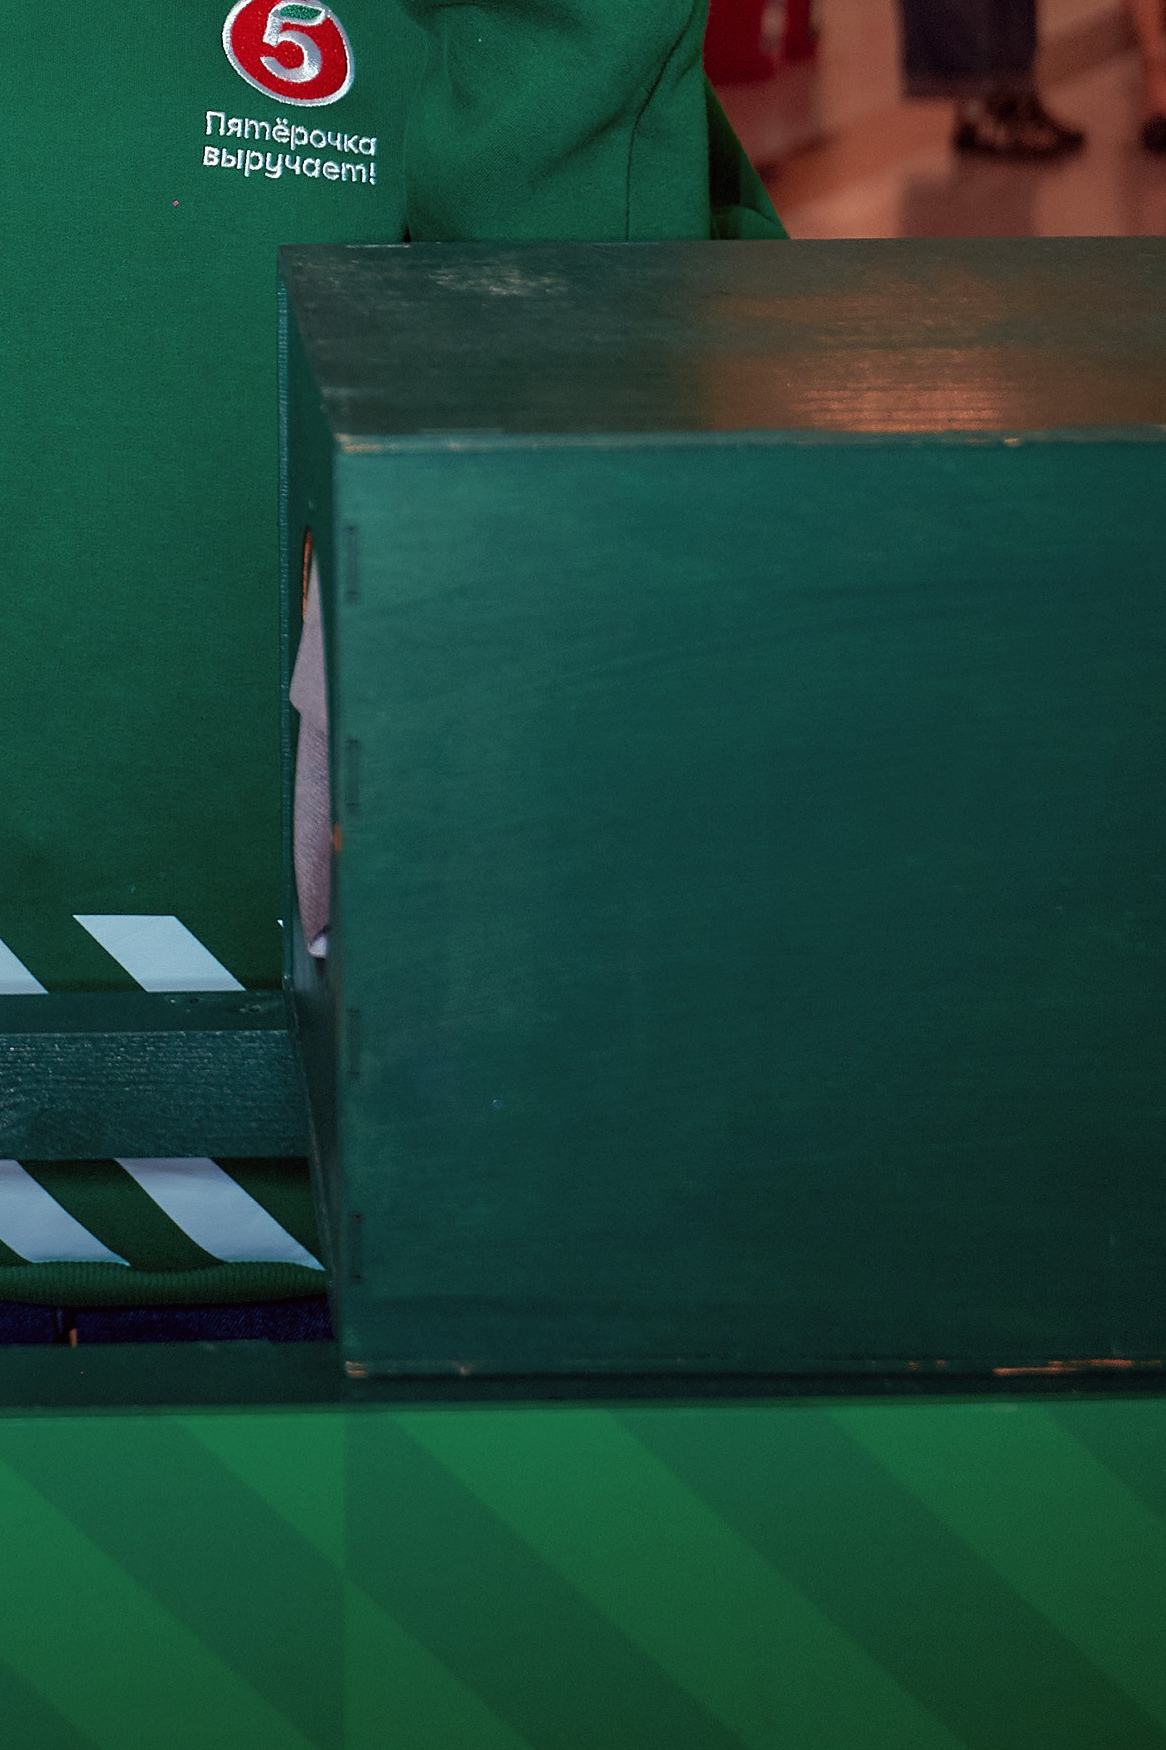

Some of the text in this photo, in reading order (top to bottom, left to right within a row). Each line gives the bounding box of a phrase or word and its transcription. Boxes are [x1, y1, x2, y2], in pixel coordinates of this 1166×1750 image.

[260, 2, 325, 83] 5
[205, 110, 377, 156] Пятёрочка
[203, 146, 377, 185] выручает!
